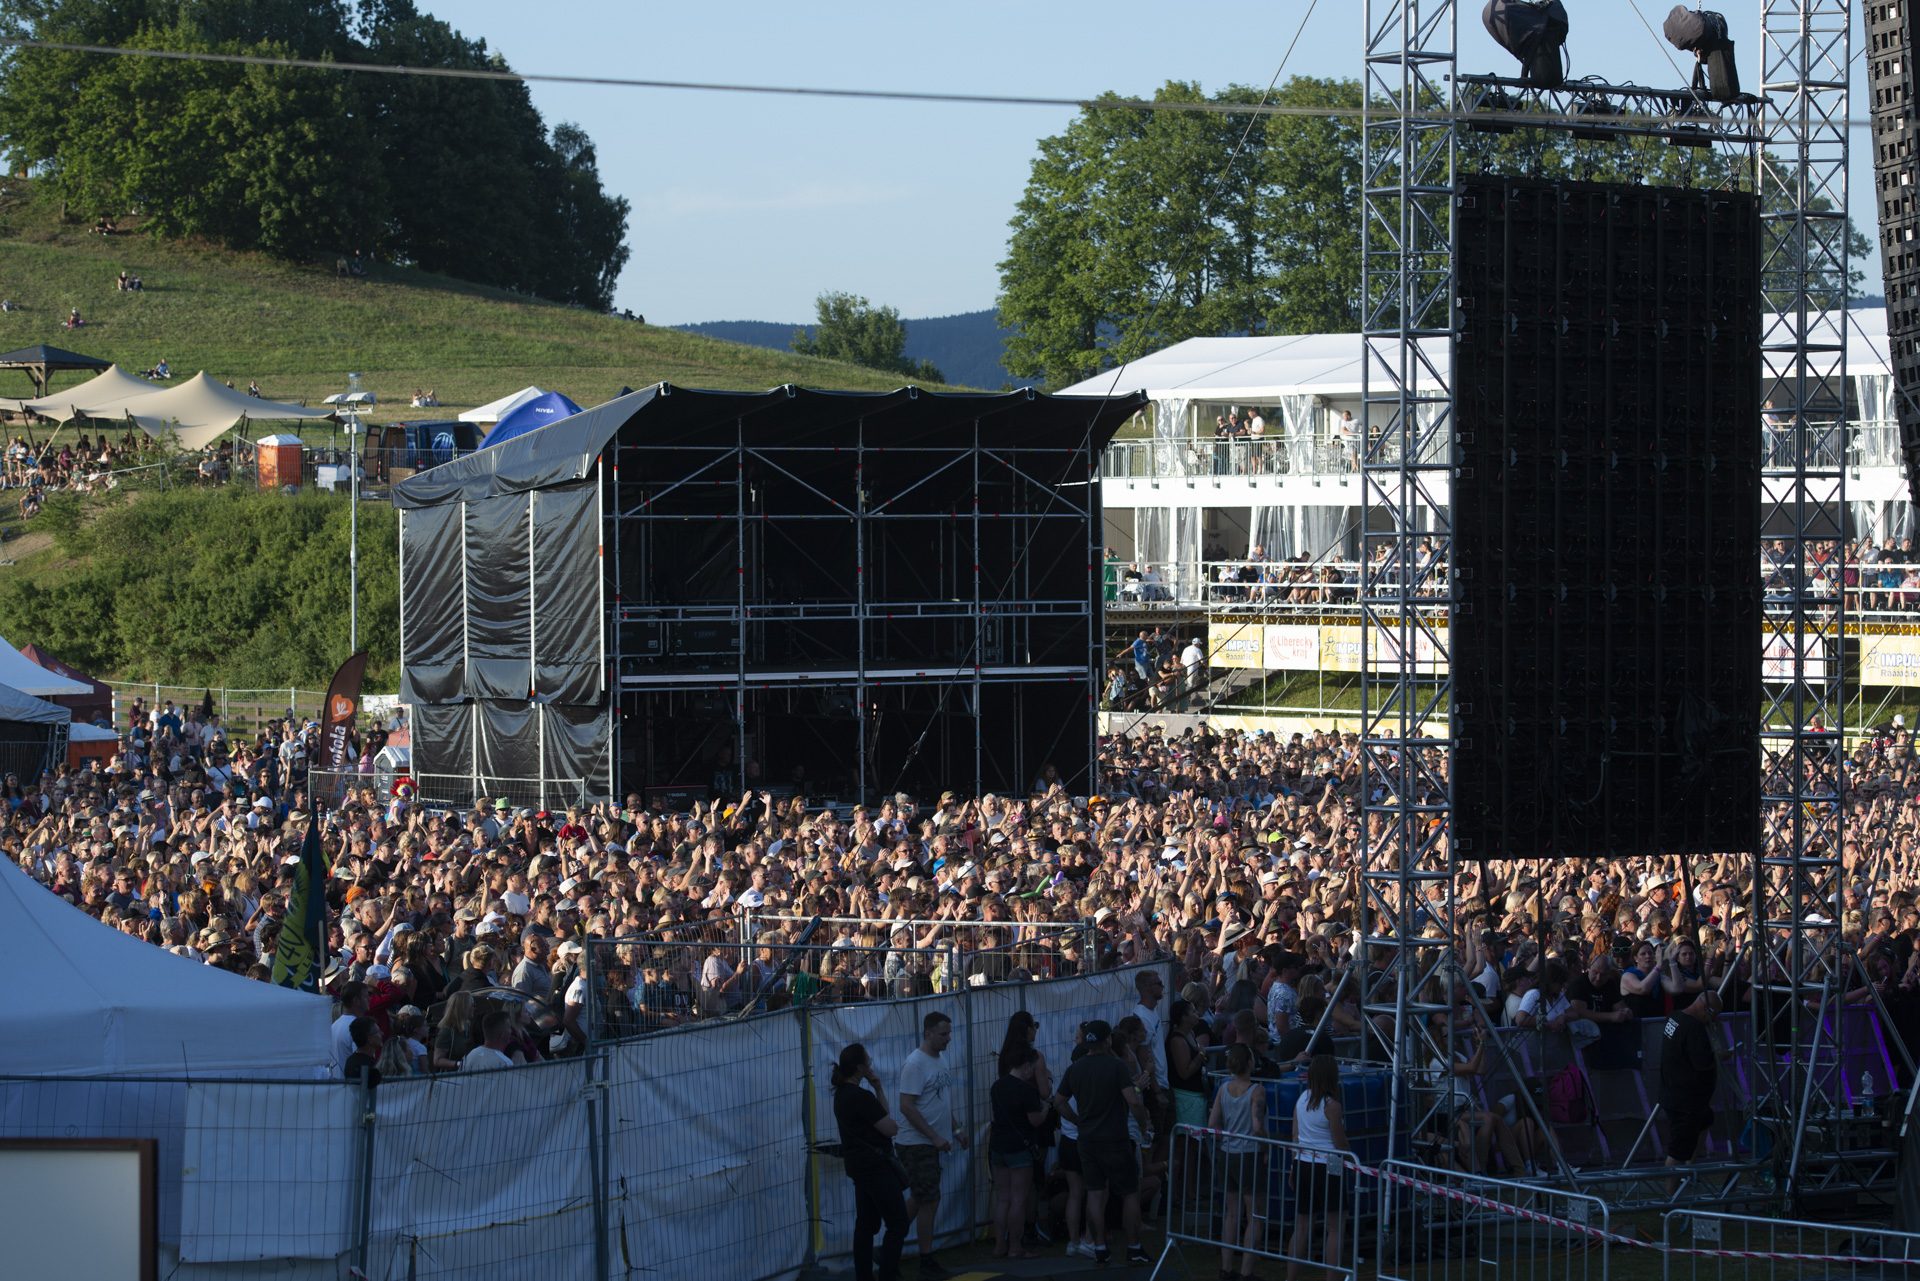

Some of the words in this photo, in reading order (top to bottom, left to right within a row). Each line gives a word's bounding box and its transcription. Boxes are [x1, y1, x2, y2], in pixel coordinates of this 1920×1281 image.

[1226, 639, 1260, 652] IMPULS
[1336, 641, 1374, 655] IMPUS
[1880, 653, 1920, 667] IMPUL
[327, 725, 347, 772] kofola
